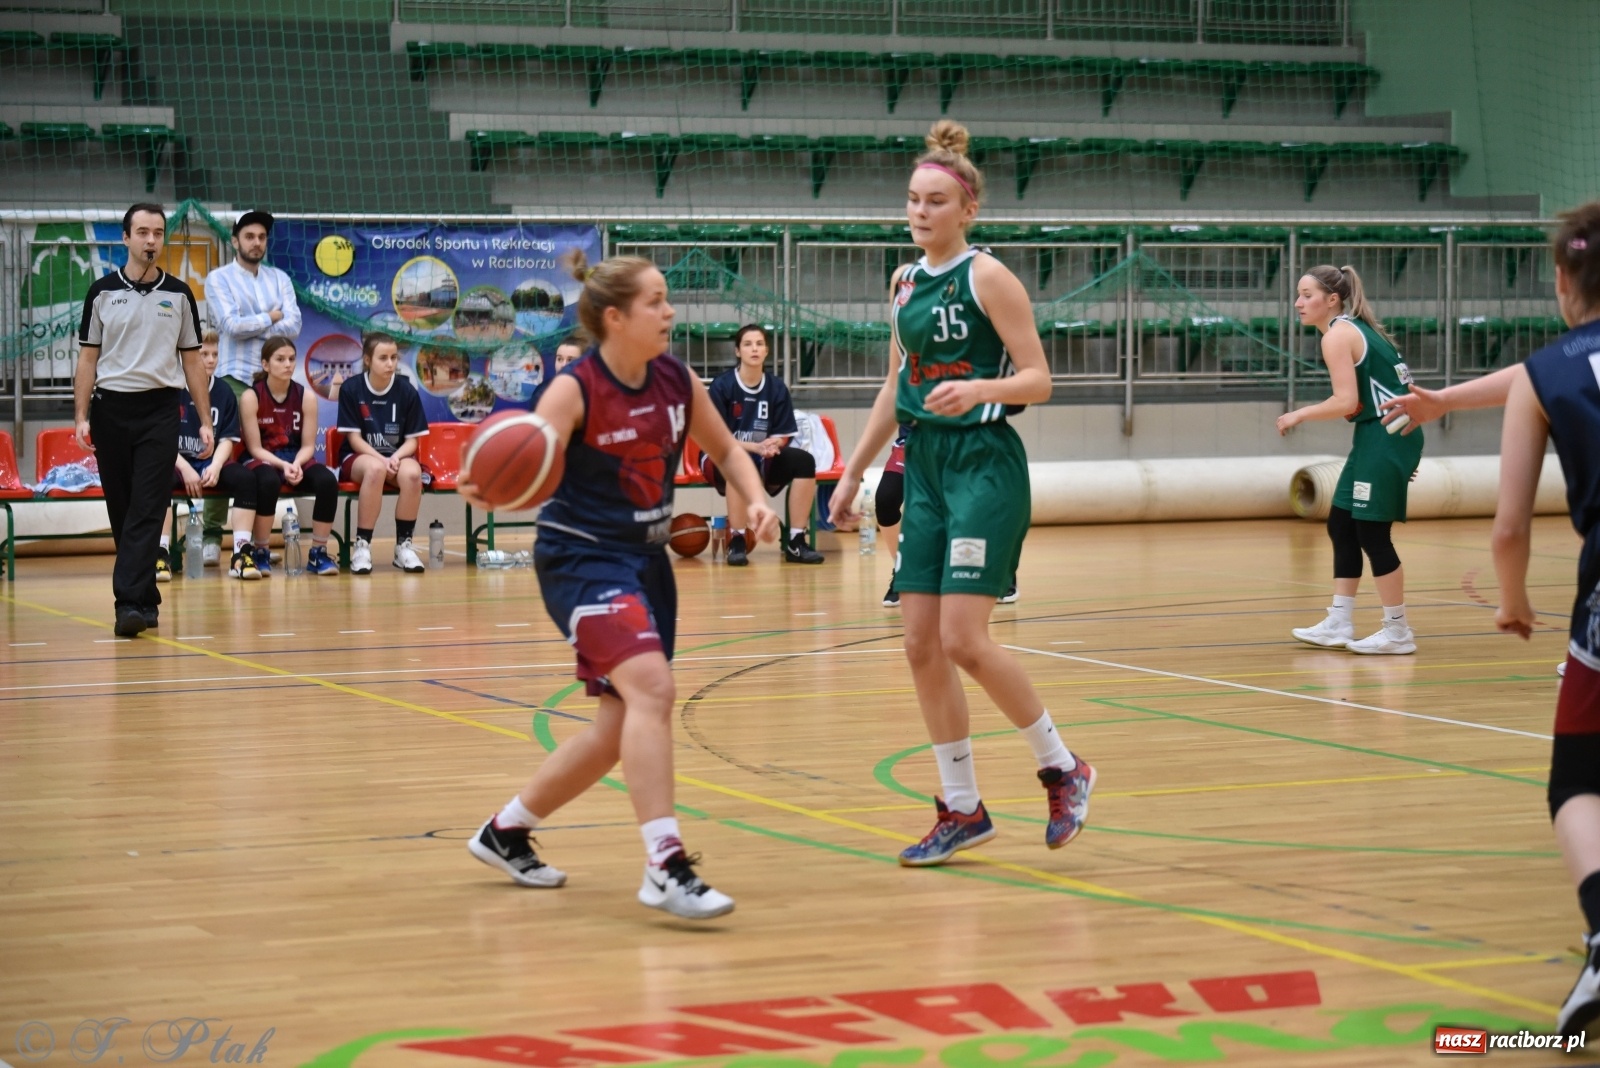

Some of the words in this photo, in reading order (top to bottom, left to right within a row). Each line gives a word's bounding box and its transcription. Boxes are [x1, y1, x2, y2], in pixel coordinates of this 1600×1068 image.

[372, 235, 431, 250] Ośrodek
[435, 236, 479, 252] Sportu
[484, 237, 488, 249] i
[492, 238, 556, 254] Rekreacji
[472, 258, 484, 267] w
[489, 255, 556, 269] Raciborzu
[931, 303, 969, 342] 35
[293, 411, 300, 430] 2
[392, 403, 396, 422] 1
[396, 970, 1322, 1068] RAFAKO
